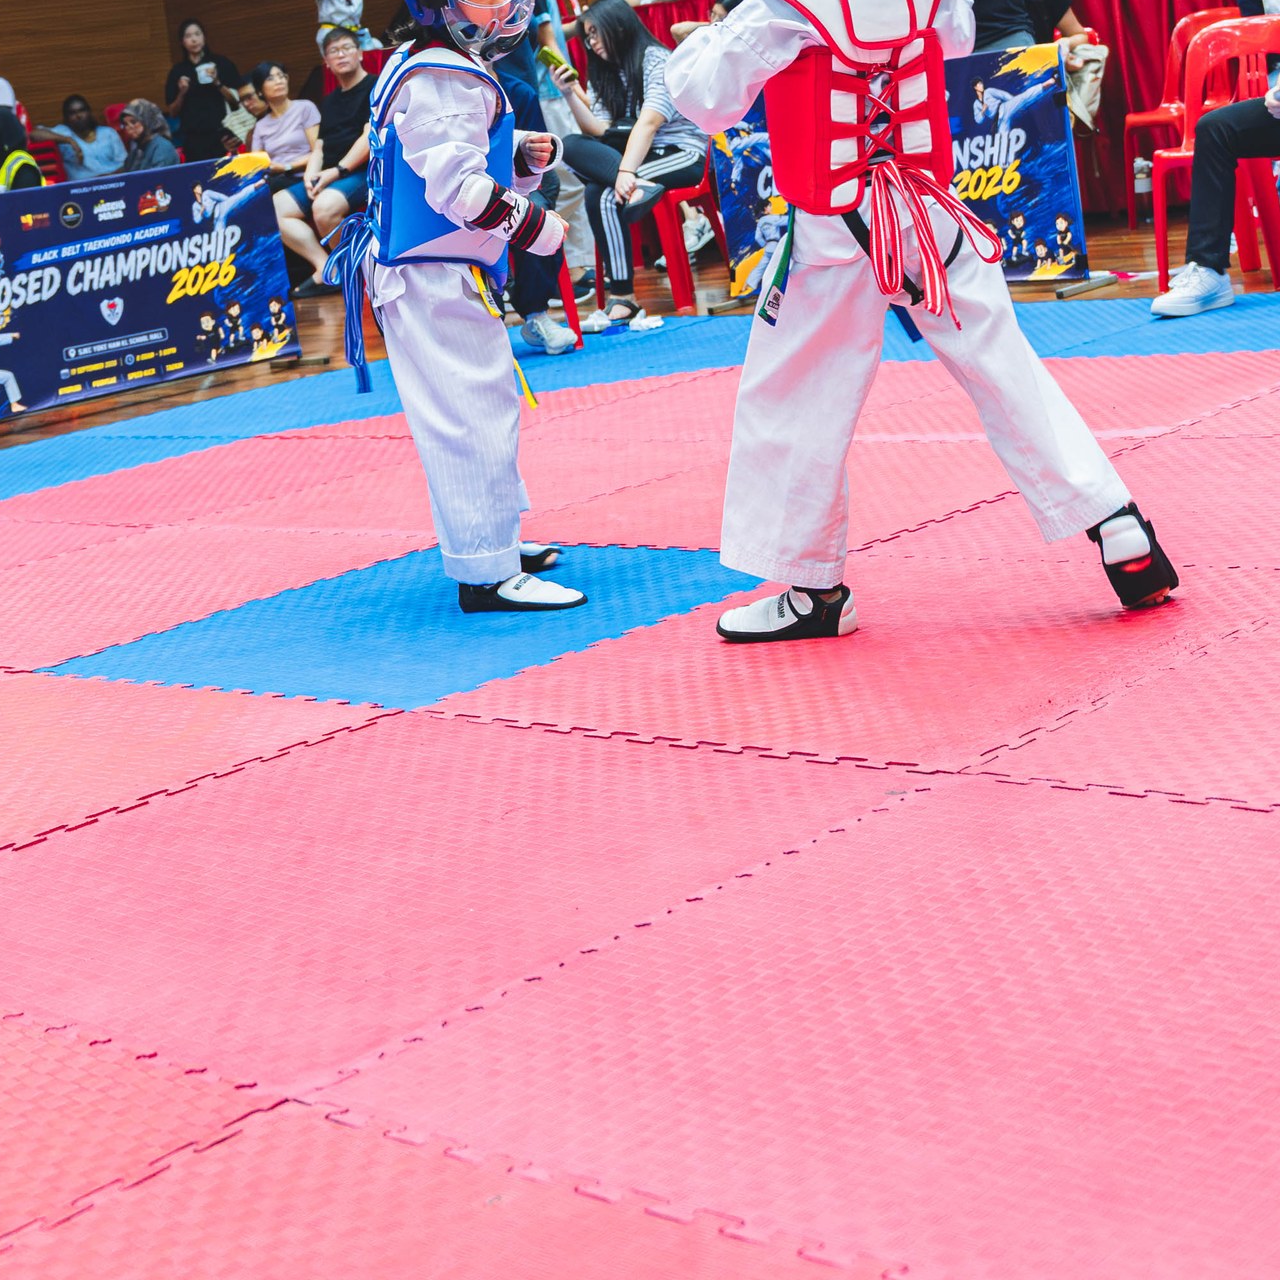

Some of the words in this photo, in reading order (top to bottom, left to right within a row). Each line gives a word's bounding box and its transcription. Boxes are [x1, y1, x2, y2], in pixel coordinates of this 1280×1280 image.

[952, 159, 1022, 201] 2026
[31, 250, 58, 264] BLACK
[61, 244, 81, 258] BELT
[83, 234, 132, 252] TAEKWONDO
[134, 224, 170, 240] ACADEMY
[67, 225, 242, 295] CHAMPIONSHIP
[166, 254, 237, 305] 2026
